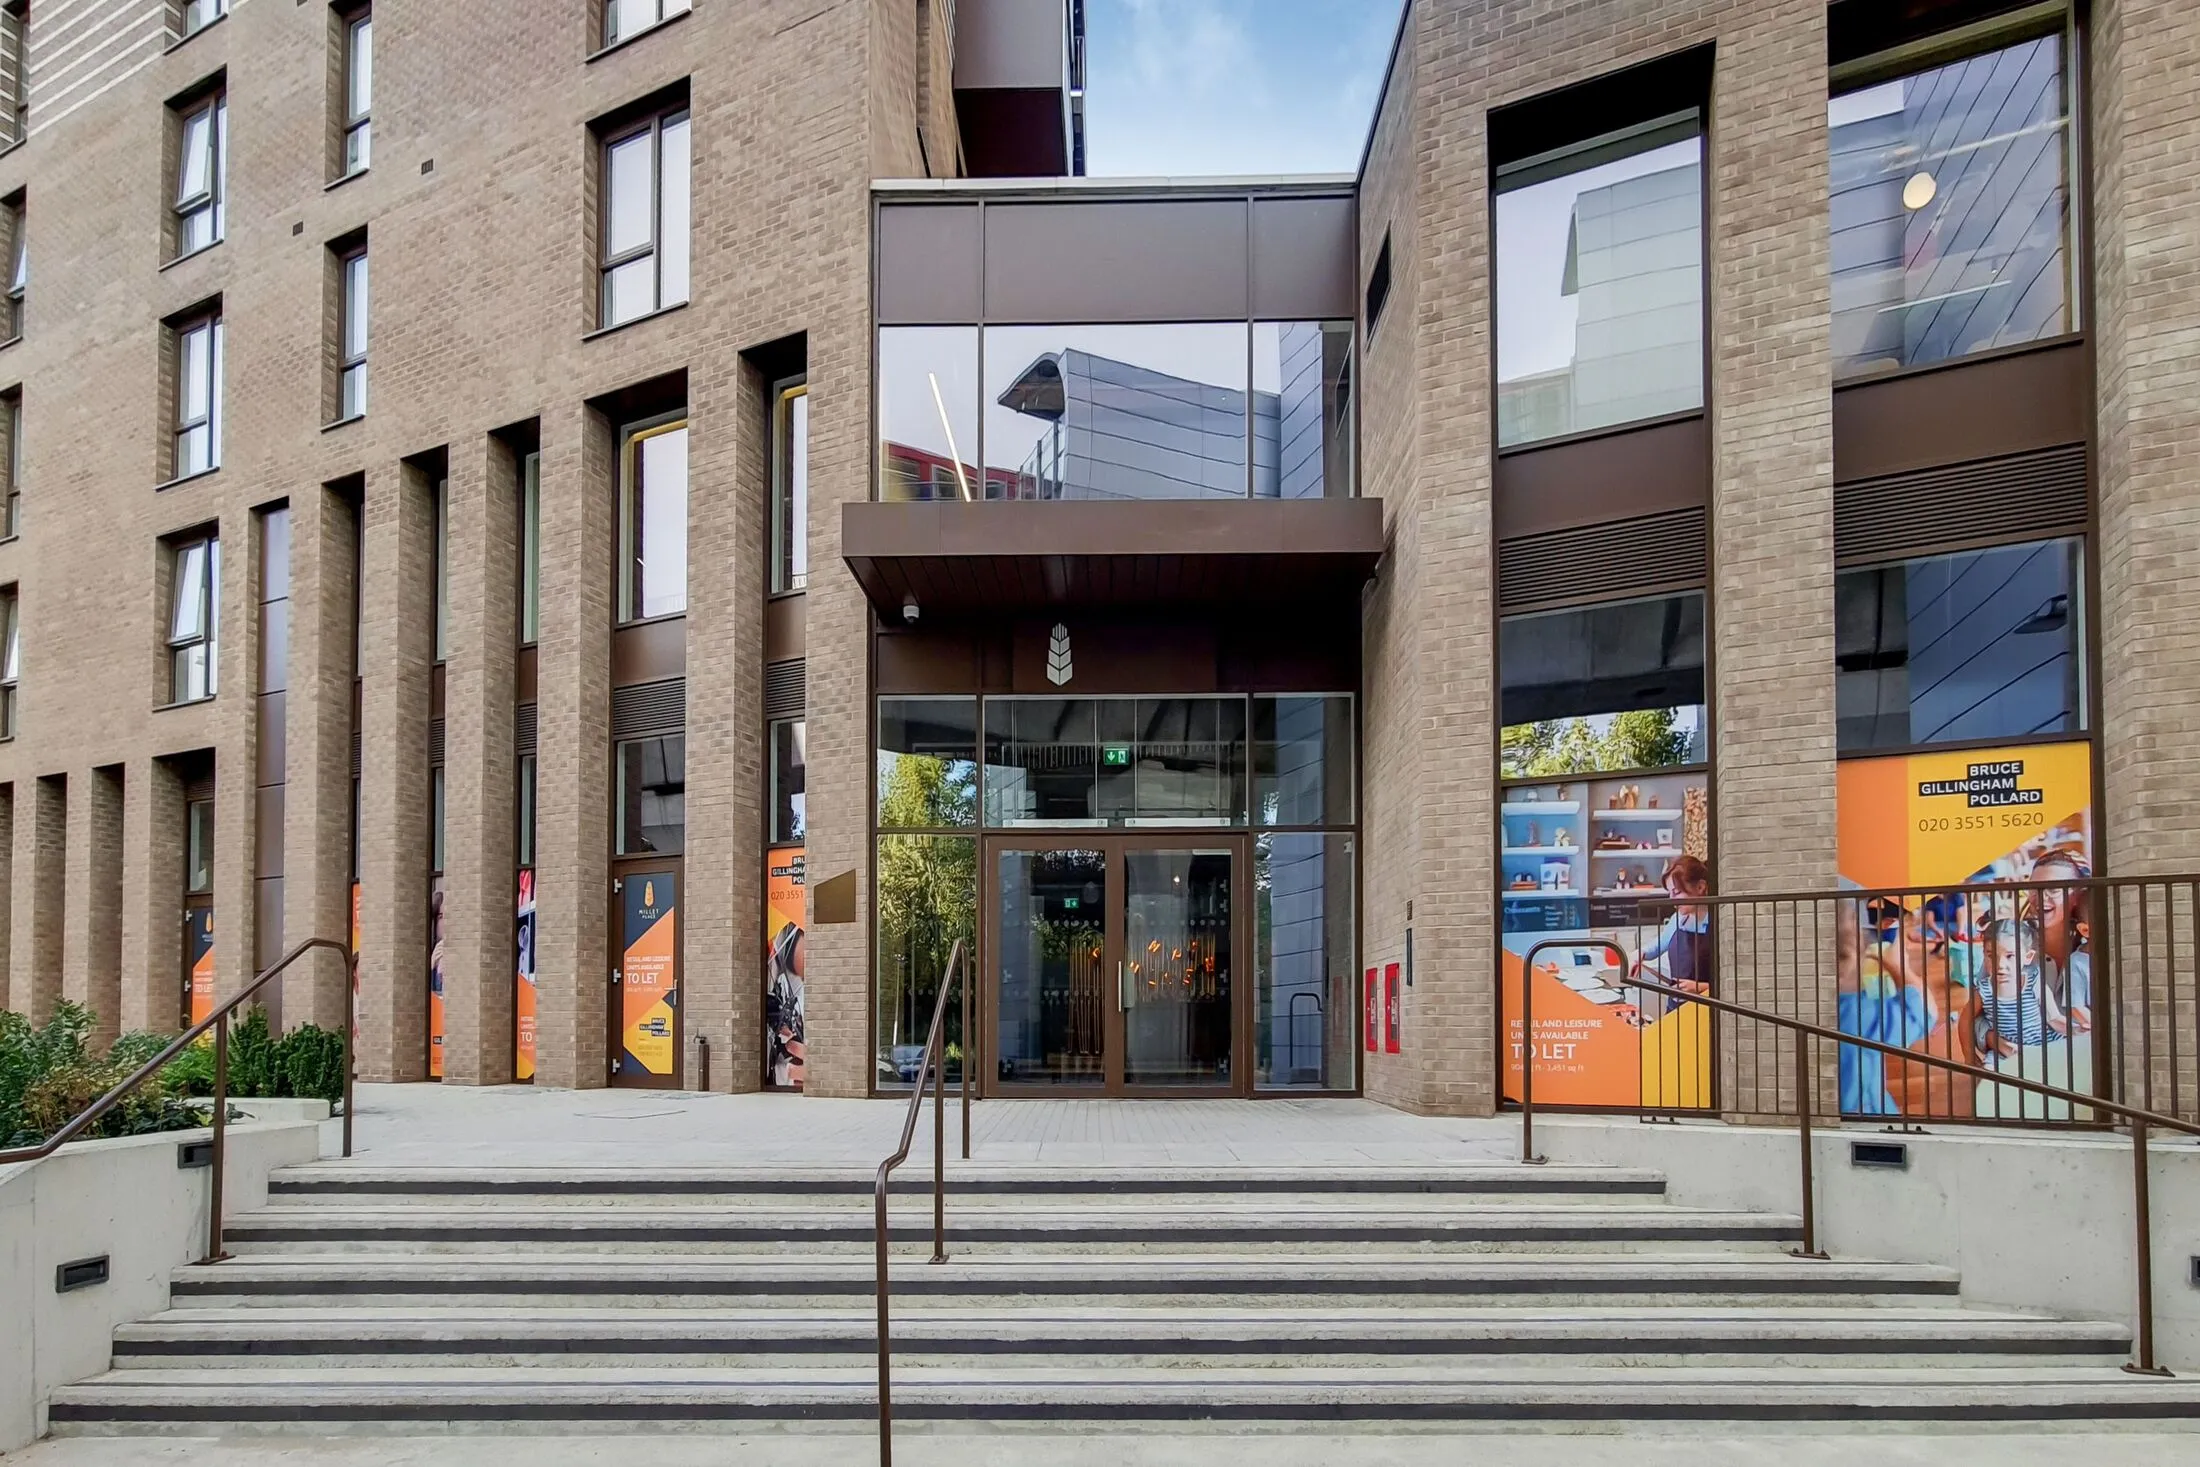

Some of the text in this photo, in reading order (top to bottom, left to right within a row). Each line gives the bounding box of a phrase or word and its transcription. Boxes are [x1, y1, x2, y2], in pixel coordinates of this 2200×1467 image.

[1969, 762, 2020, 777] BRUCE
[1921, 777, 2014, 795] GILLINGHAM
[1970, 791, 2040, 806] POLLARD
[1918, 812, 2044, 832] 020 3551 5620
[626, 972, 658, 984] TO LET
[1541, 1019, 1562, 1028] AND
[1564, 1019, 1603, 1028] LEISURE
[520, 1031, 533, 1042] TO
[1540, 1031, 1589, 1040] AVAILABLE
[1542, 1043, 1577, 1060] LET
